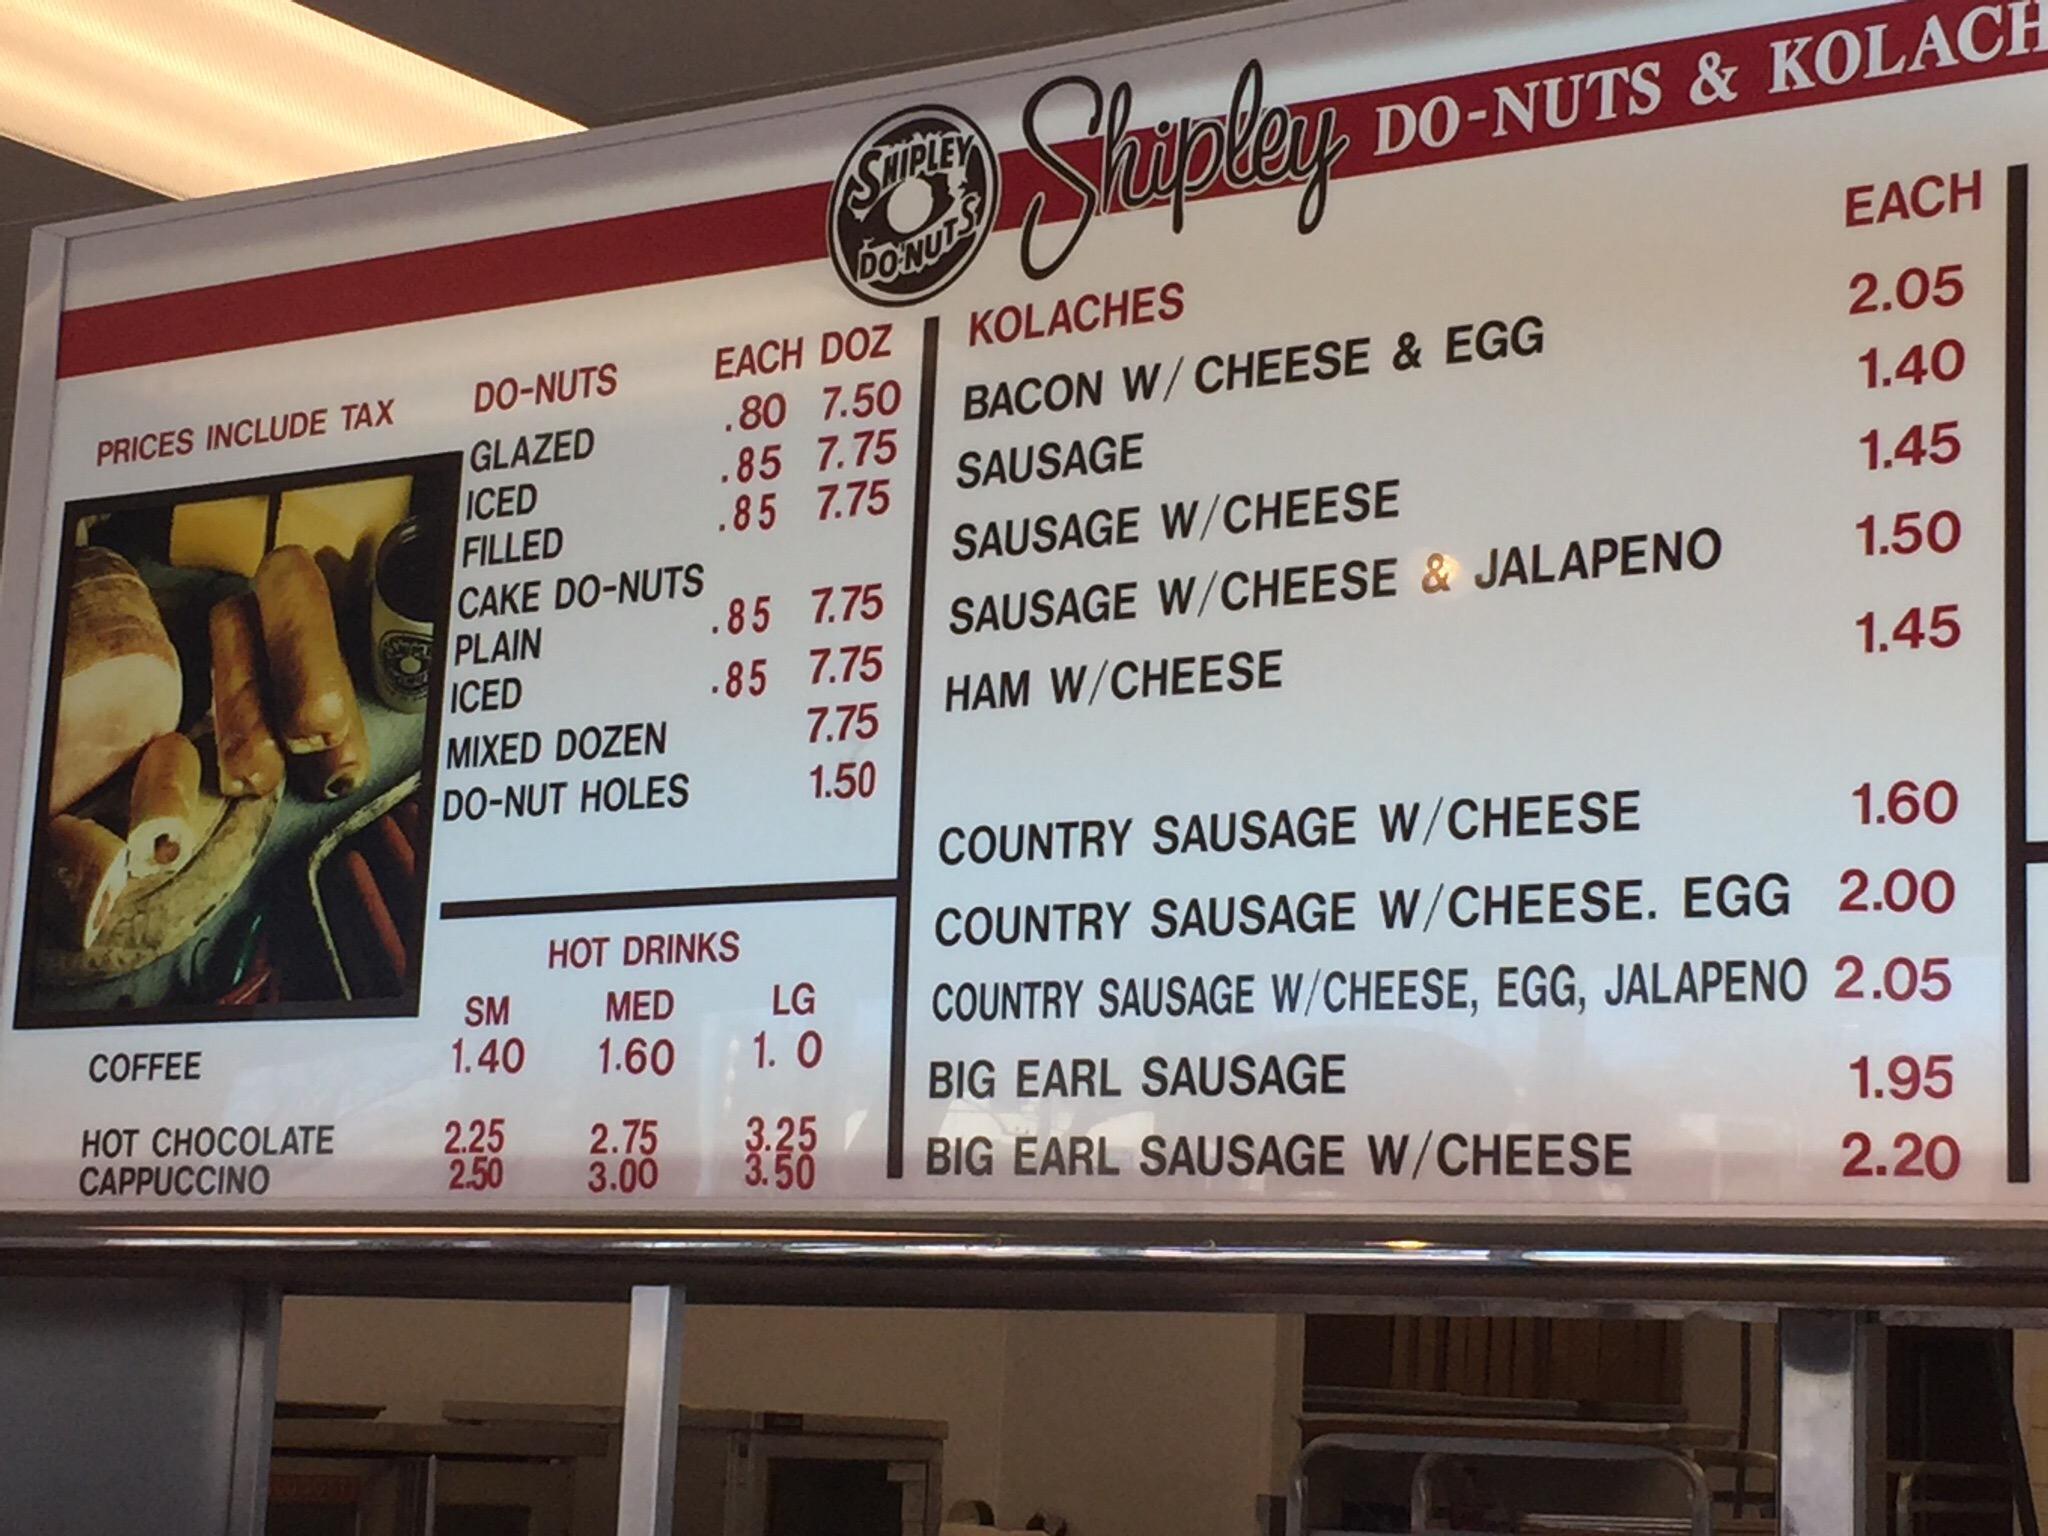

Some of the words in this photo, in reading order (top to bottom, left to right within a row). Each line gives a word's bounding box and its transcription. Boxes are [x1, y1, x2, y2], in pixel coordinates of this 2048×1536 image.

[849, 135, 973, 209] SHIPLEY
[1020, 58, 1350, 280] Shipley
[1374, 60, 1662, 156] DO-NUTS
[1689, 51, 1738, 106] &
[1768, 1, 2048, 95] KOLACH
[1846, 169, 1981, 227] EACH
[969, 282, 1184, 347] KOLACHES
[1849, 264, 1964, 315] 2.05
[475, 363, 617, 413] DO-NUTS
[715, 336, 803, 380] EACH
[821, 323, 892, 365] DOZ
[964, 370, 1103, 421] BACON
[1392, 332, 1421, 371] &
[1446, 316, 1543, 364] EGG
[1859, 339, 1965, 388] 1.40
[97, 428, 194, 466] PRICES
[207, 408, 328, 450] INCLUDE
[341, 399, 394, 431] TAX
[470, 428, 594, 473] GLAZED
[726, 393, 786, 432] .80
[823, 380, 901, 420] 7.50
[1859, 421, 1961, 470] 1.45
[466, 483, 537, 521] ICED
[722, 444, 781, 483] .85
[818, 428, 897, 471] 7.75
[957, 432, 1144, 489] SAUSAGE
[463, 527, 563, 568] FILLED
[719, 493, 776, 531] .85
[818, 479, 890, 520] 7.75
[952, 506, 1140, 561] SAUSAGE
[1161, 479, 1400, 540] W/CHEESE
[1856, 510, 1961, 556] 1.50
[458, 580, 541, 619] CAKE
[555, 563, 704, 610] DO-NUTS
[949, 582, 1137, 635] SAUSAGE
[1158, 558, 1397, 617] W/CHEESE
[1422, 553, 1450, 594] &
[1475, 527, 1722, 589] JALAPENO
[454, 627, 541, 666] PLAIN
[712, 596, 770, 635] .85
[812, 583, 883, 624] 7.75
[1856, 604, 1961, 653] 1.45
[451, 677, 522, 714] ICED
[712, 659, 767, 698] .85
[810, 645, 883, 684] 7.75
[946, 670, 1030, 712] HAM
[1050, 649, 1282, 705] W/CHEESE
[447, 731, 541, 769] MIXED
[556, 721, 666, 761] DOZEN
[807, 702, 878, 743] 7.75
[443, 782, 568, 821] DO-NUT
[581, 773, 689, 813] HOLES
[810, 761, 876, 799] 1.50
[939, 818, 1132, 865] COUNTRY
[1153, 806, 1356, 855] SAUSAGE
[1379, 790, 1640, 845] W/CHEESE
[1852, 780, 1958, 824] 1.60
[935, 901, 1131, 946] COUNTRY
[1151, 892, 1356, 939] SAUSAGE
[1684, 873, 1789, 918] EGG
[1839, 869, 1955, 914] 2.00
[549, 937, 610, 969] HOT
[624, 931, 739, 966] DRINKS
[465, 996, 509, 1027] SM
[606, 990, 674, 1022] MED
[773, 983, 815, 1015] LG
[933, 980, 1083, 1022] COUNTRY
[1099, 974, 1255, 1018] SAUSAGE
[1272, 968, 1477, 1017] W/CHEESE,
[1498, 964, 1585, 1014] EGG,
[1605, 958, 1807, 1006] JALAPENO
[1835, 955, 1951, 1002] 2.05
[89, 1052, 201, 1083] COFFEE
[453, 1038, 525, 1074] 1.40
[600, 1037, 674, 1076] 1.60
[929, 1060, 995, 1099] BIG
[1017, 1058, 1121, 1098] EARL
[1142, 1054, 1346, 1097] SAUSAGE
[1850, 1055, 1953, 1100] 1.95
[82, 1128, 140, 1158] HOT
[152, 1125, 334, 1157] CHOCOLATE
[444, 1118, 505, 1154] 2.25
[591, 1119, 658, 1155] 2.75
[746, 1115, 818, 1152] 3.25
[927, 1136, 993, 1176] BIG
[1014, 1136, 1120, 1176] EARL
[1140, 1134, 1344, 1176] SAUSAGE
[1368, 1130, 1632, 1180] W/CHEESE
[1842, 1132, 1960, 1180] 2.20
[79, 1165, 270, 1196] CAPPUCCINO
[449, 1156, 503, 1190] 2.50
[588, 1157, 658, 1193] 3.00
[745, 1153, 816, 1191] 3.50
